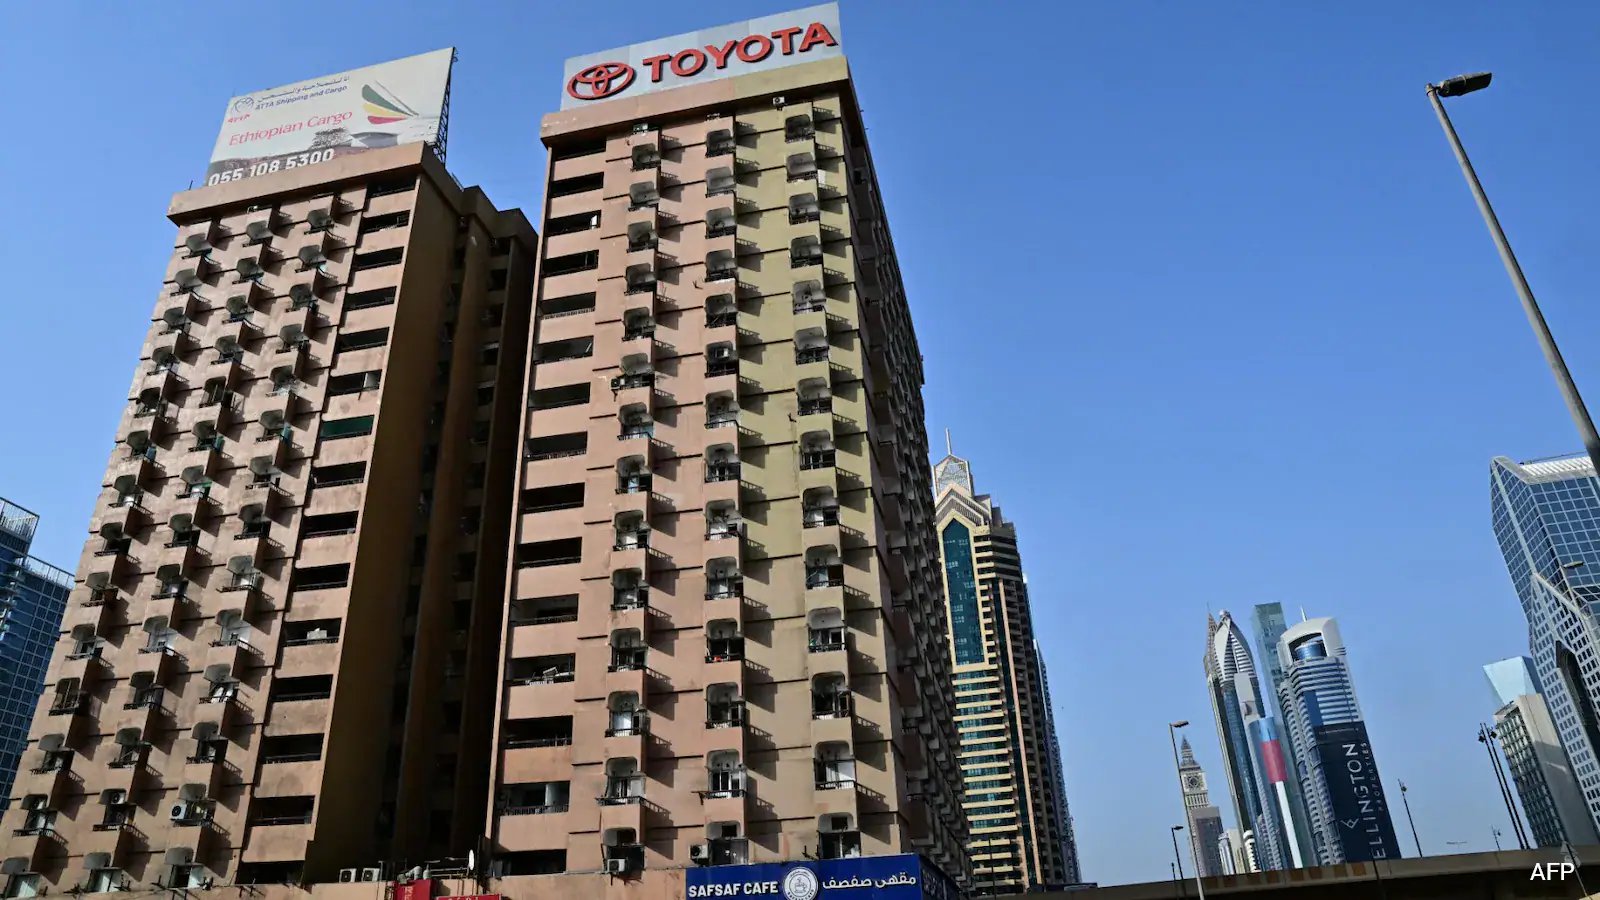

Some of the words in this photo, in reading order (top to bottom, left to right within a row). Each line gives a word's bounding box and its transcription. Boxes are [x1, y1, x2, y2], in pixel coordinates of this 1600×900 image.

[642, 22, 838, 82] TOYOTA
[255, 101, 275, 110] ATTA
[276, 94, 308, 107] Shipping
[310, 89, 324, 98] and
[325, 84, 348, 95] Cargo
[229, 121, 303, 146] Ethiopian
[307, 111, 353, 127] Cargo
[208, 167, 244, 187] 055
[249, 160, 280, 177] 108
[285, 148, 335, 170] 5300
[1342, 743, 1387, 860] ELLINGTON
[688, 884, 741, 898] SAFSAF
[743, 881, 779, 896] CAFE
[822, 876, 872, 890] صفصف
[875, 871, 917, 889] مقهى
